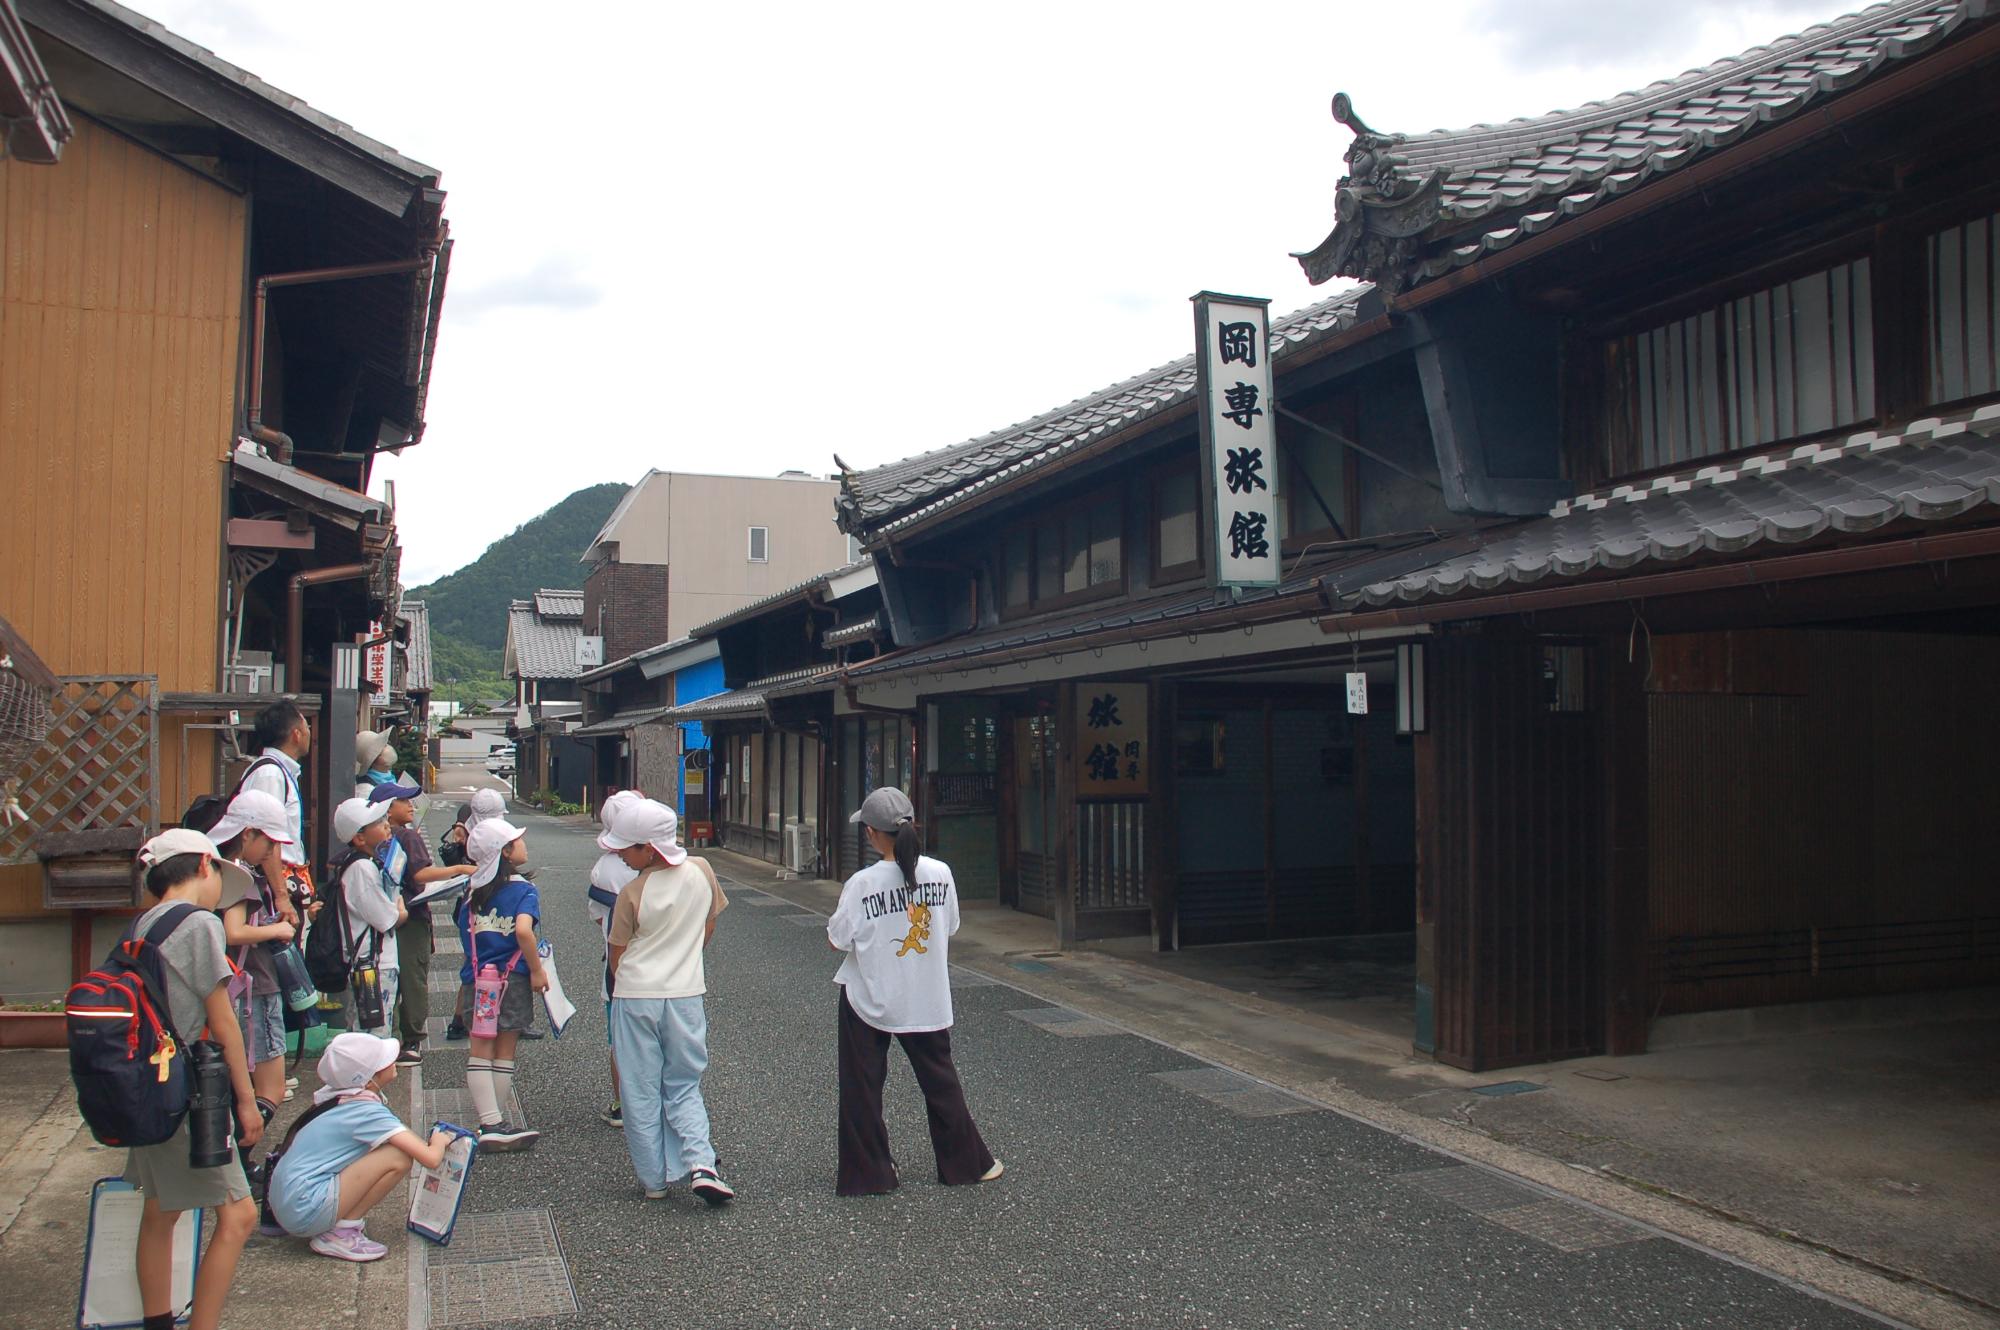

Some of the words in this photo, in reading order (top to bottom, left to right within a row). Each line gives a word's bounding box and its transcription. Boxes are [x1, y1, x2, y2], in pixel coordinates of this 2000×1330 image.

[1219, 321, 1269, 559] 岡専旅館
[862, 891, 888, 920] TOM
